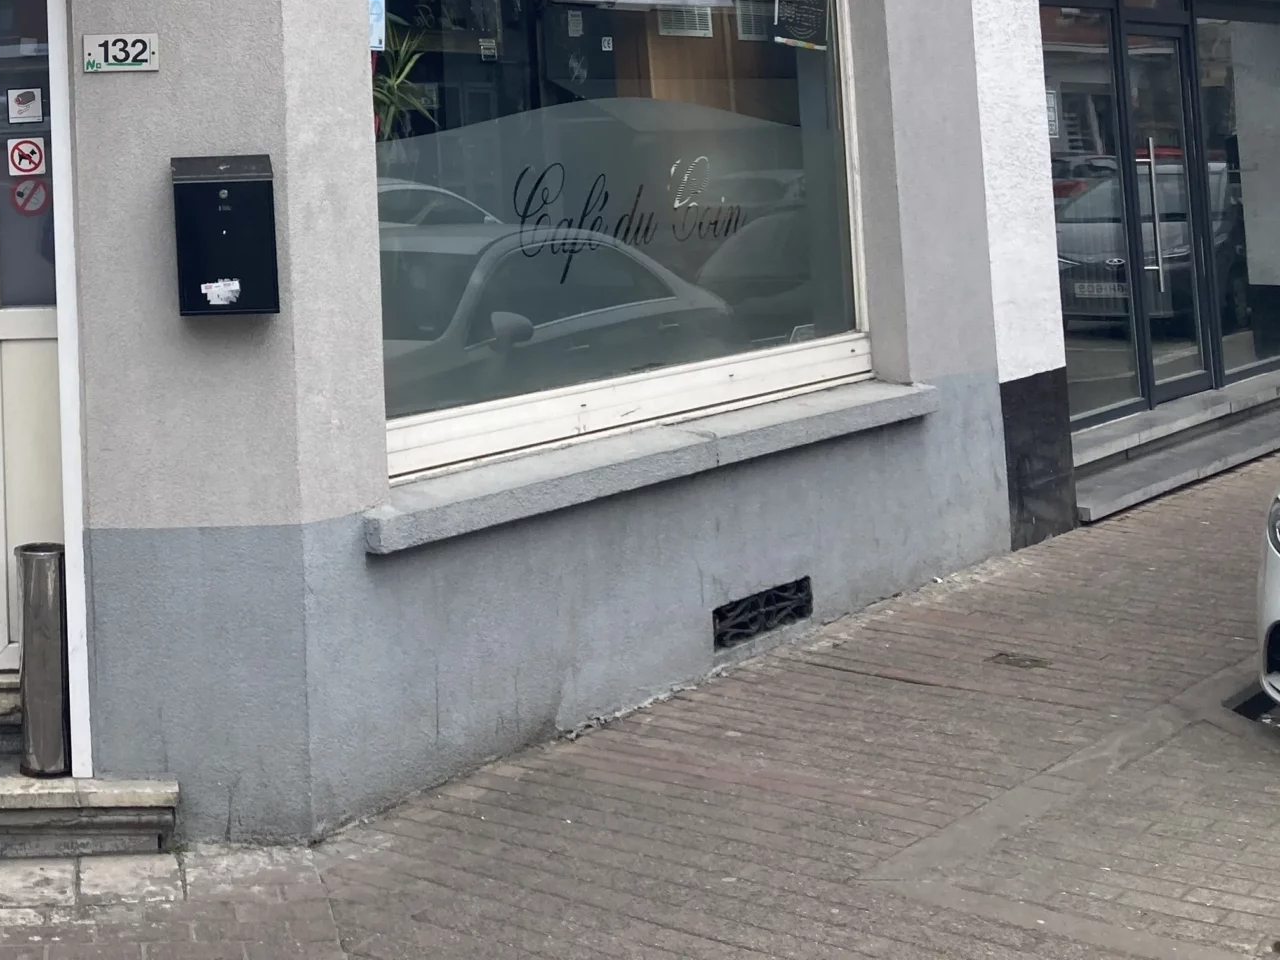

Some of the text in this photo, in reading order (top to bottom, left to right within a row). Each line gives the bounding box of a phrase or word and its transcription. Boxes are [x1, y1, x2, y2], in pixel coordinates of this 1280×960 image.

[97, 38, 149, 64] 132
[514, 162, 610, 284] Café
[612, 184, 659, 246] du
